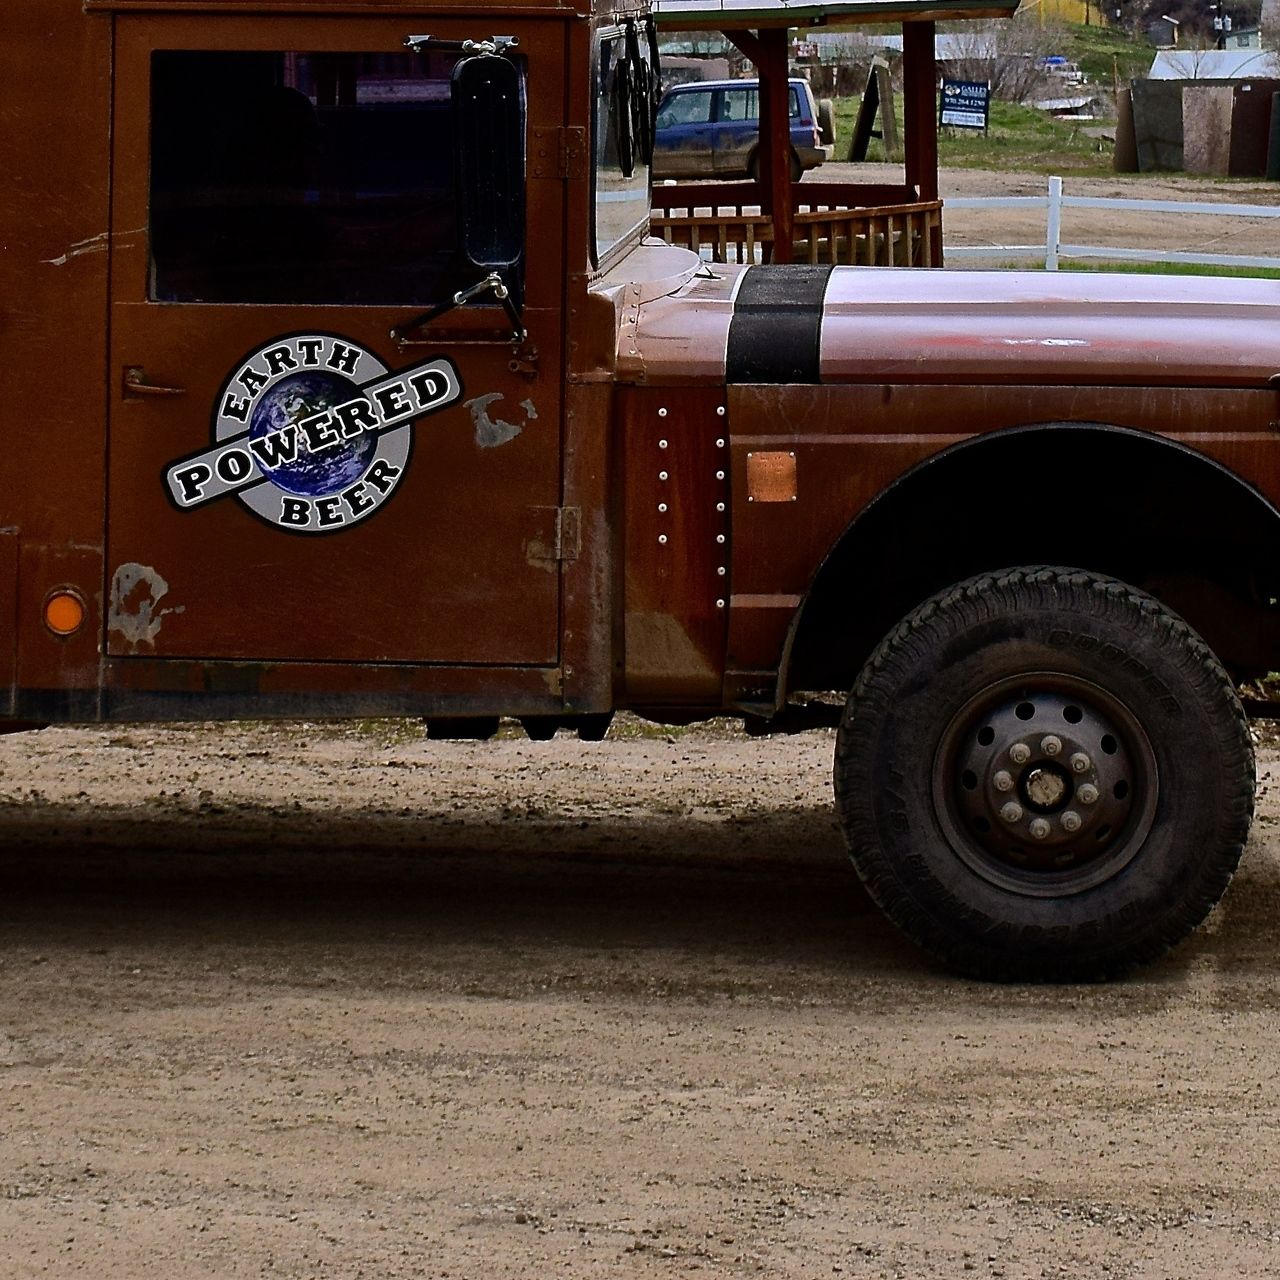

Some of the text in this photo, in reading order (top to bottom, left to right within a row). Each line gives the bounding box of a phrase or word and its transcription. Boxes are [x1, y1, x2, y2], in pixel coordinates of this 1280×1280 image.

[223, 339, 362, 423] EARTH
[174, 368, 451, 504] POWERED
[279, 458, 401, 528] BEER
